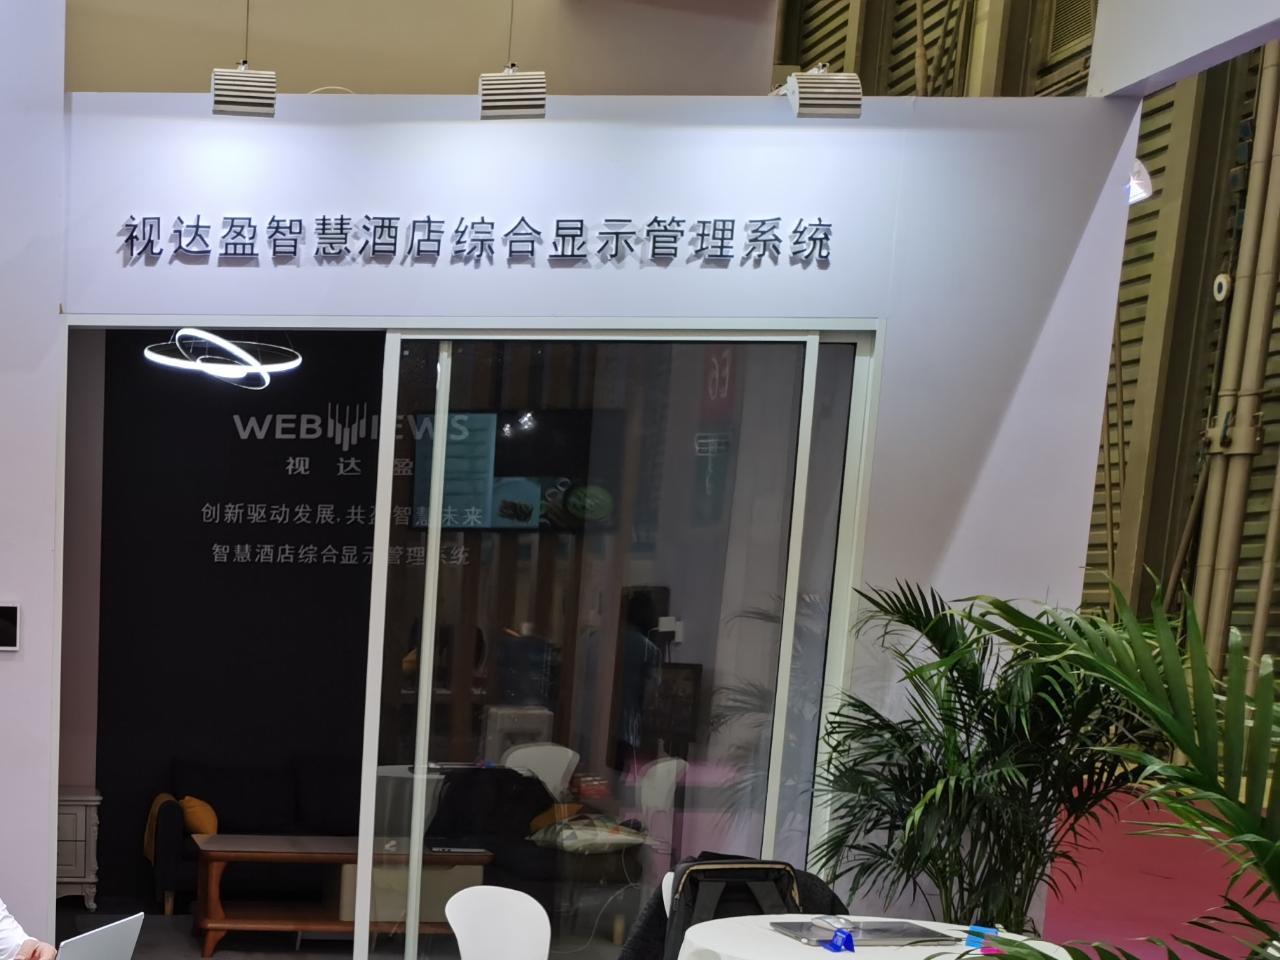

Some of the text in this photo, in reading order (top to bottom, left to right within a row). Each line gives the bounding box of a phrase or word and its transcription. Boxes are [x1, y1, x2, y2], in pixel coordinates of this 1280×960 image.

[120, 213, 833, 261] 视达盈智慧酒店综合显示管理系统
